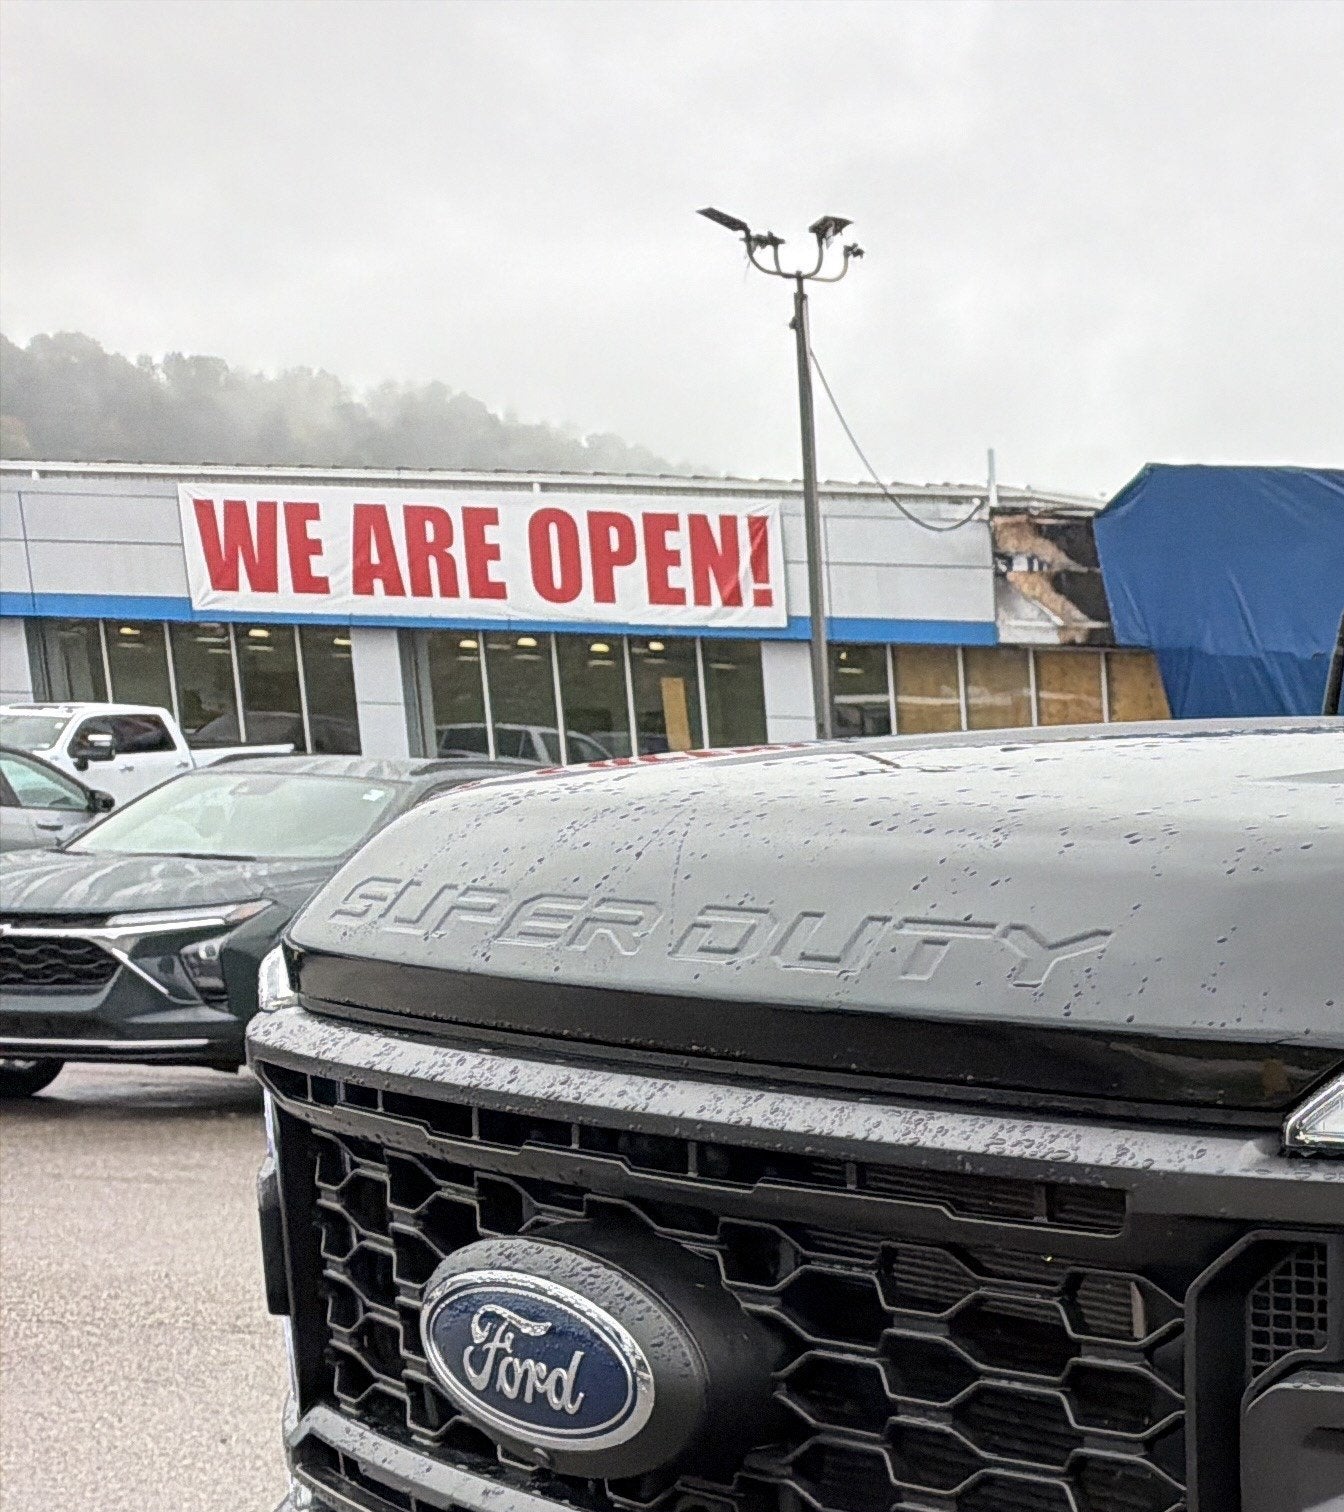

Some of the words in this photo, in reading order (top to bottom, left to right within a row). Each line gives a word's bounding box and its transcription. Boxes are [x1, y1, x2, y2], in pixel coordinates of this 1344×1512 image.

[193, 499, 331, 595] WE
[352, 503, 508, 600] ARE
[528, 508, 775, 608] OPEN!
[330, 877, 666, 956] SUPER
[668, 904, 1115, 988] DUTY
[463, 1303, 585, 1416] Ford
